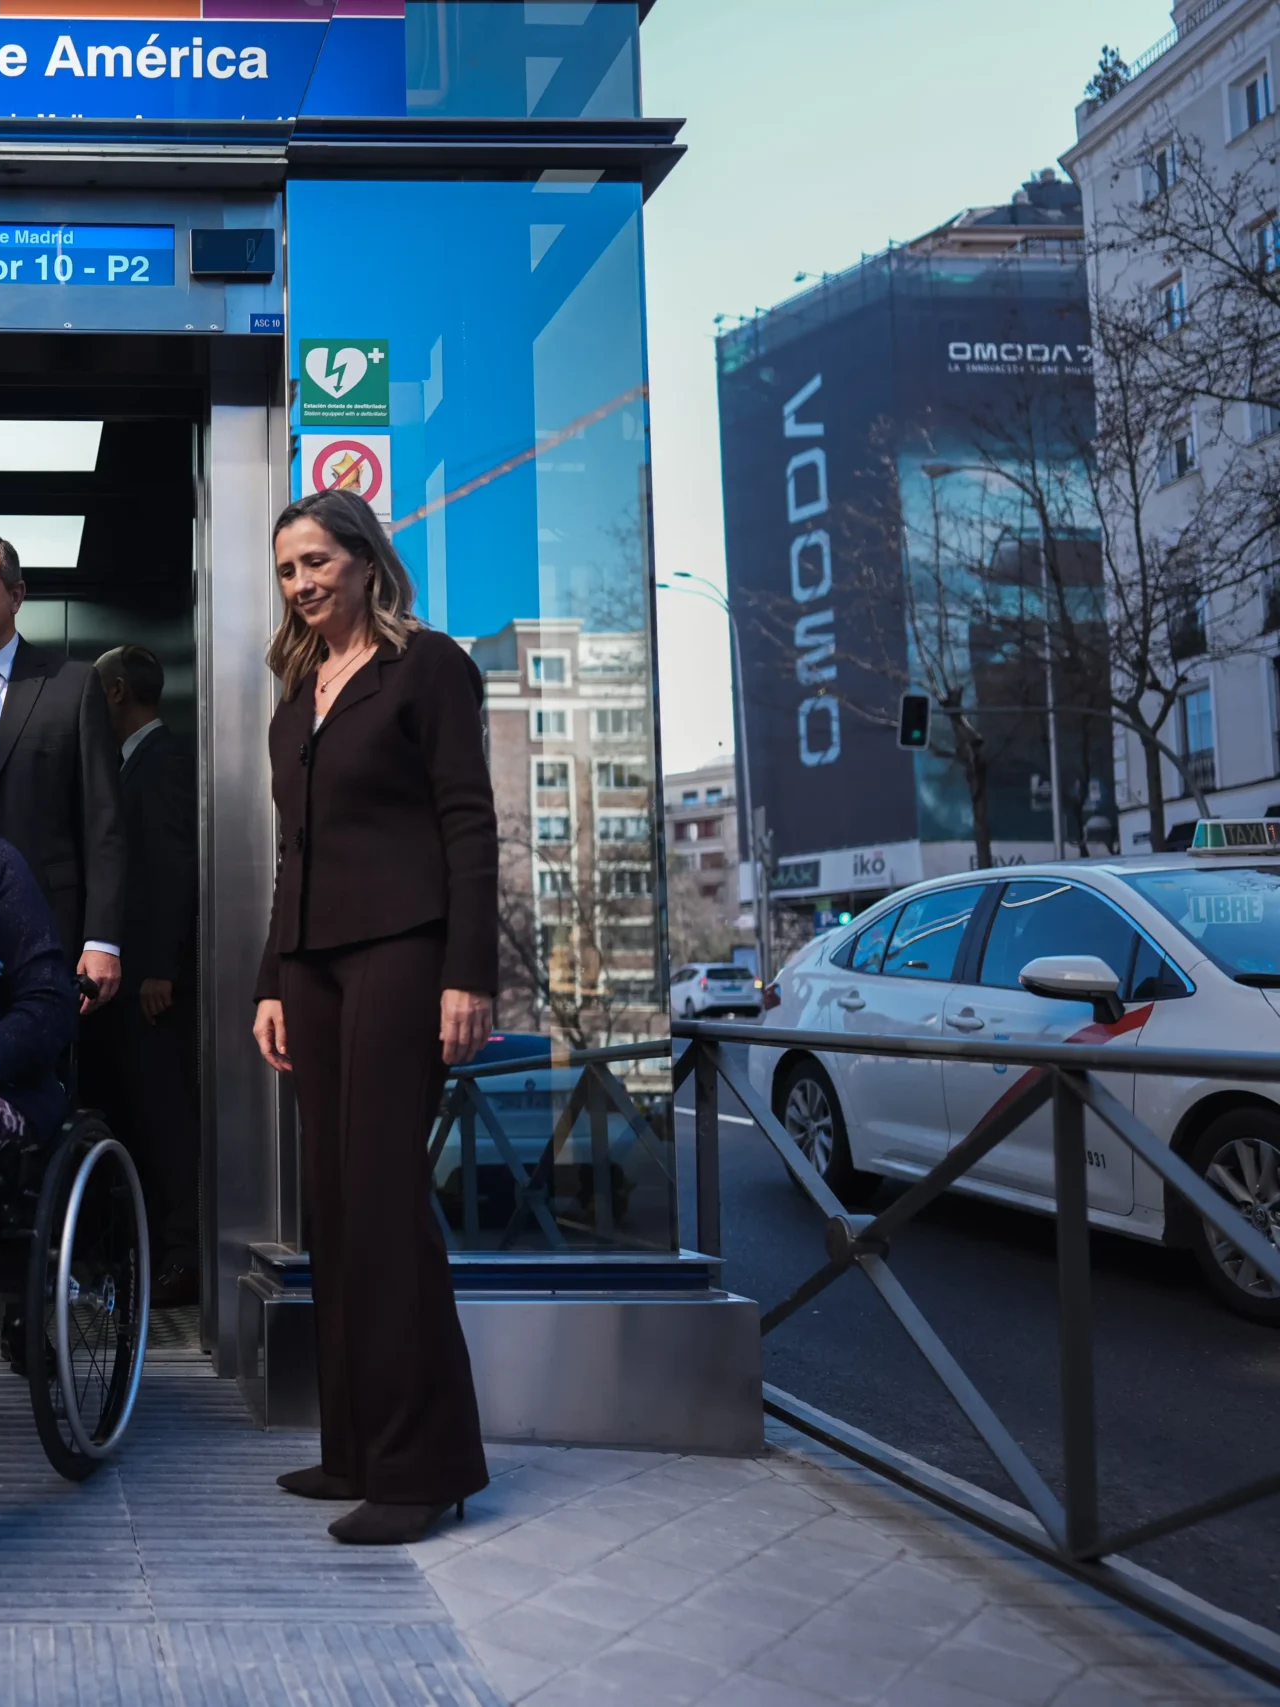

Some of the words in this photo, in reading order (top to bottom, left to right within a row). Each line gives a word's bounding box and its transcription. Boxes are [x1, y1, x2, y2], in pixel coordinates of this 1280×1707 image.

[45, 33, 269, 79] América
[14, 230, 74, 245] Madrid
[35, 254, 73, 282] 10
[107, 255, 150, 282] P2
[254, 319, 270, 328] ASC
[271, 319, 281, 328] 10
[948, 342, 1073, 363] OMODA
[783, 372, 841, 767] OMODA
[1225, 825, 1265, 844] TAXI
[1192, 896, 1261, 923] LIBRE
[1085, 1150, 1106, 1169] 931
